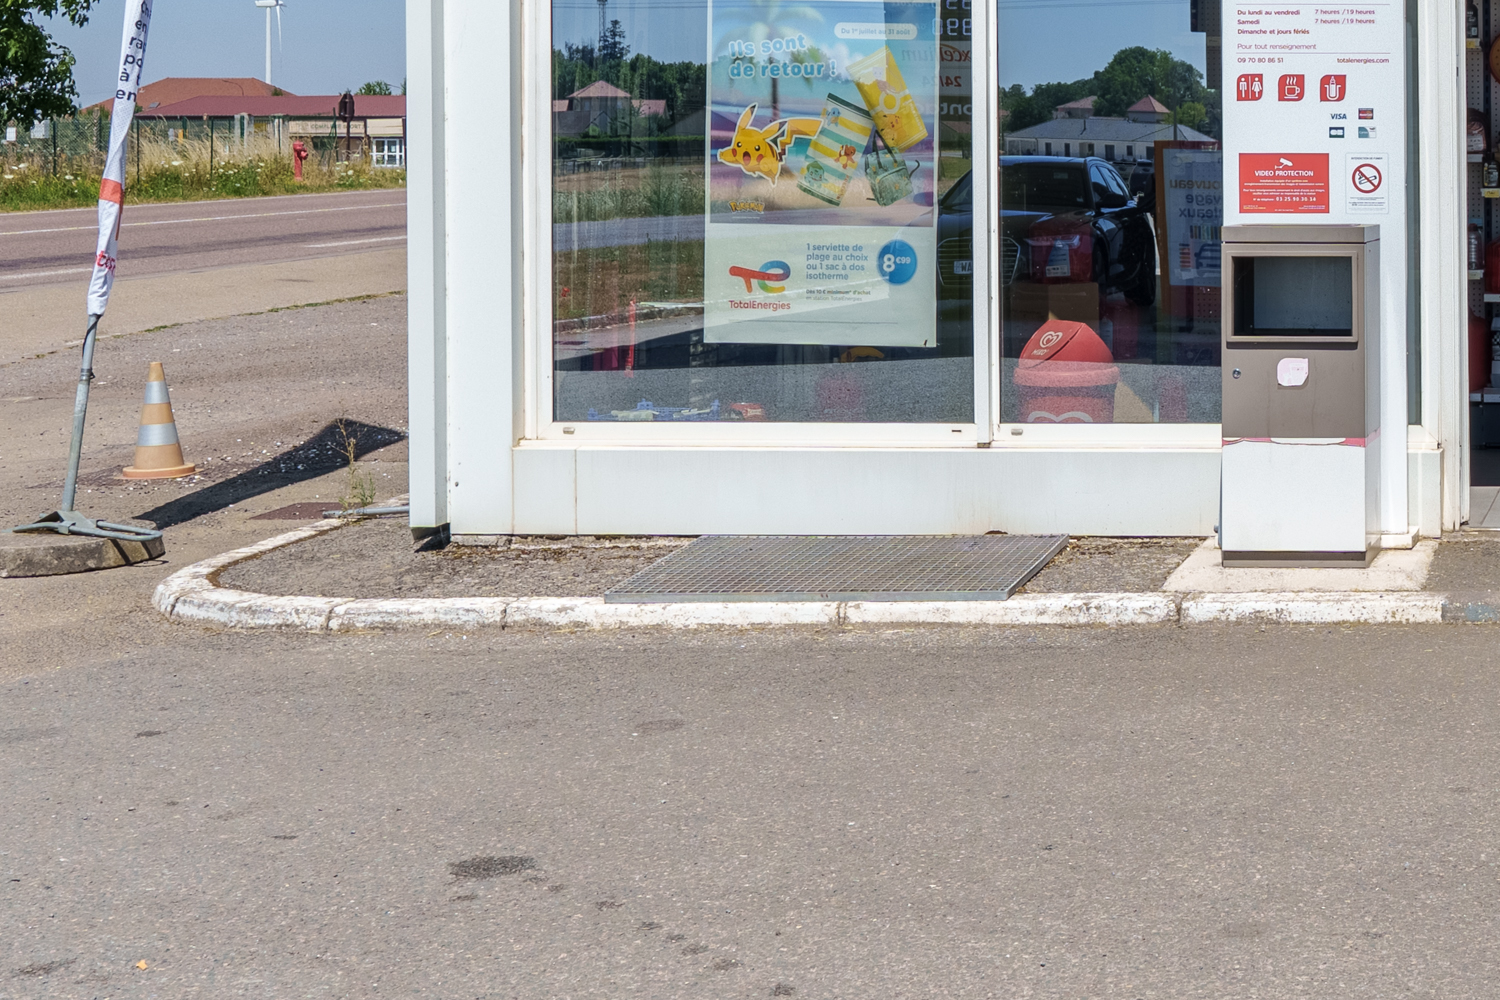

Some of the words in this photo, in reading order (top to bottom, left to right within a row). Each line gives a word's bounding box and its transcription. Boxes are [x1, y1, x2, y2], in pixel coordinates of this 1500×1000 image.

[1276, 28, 1292, 36] jours
[728, 39, 756, 58] Ils
[760, 33, 807, 55] sont
[1269, 43, 1317, 51] renseignement
[728, 61, 756, 79] de
[760, 61, 825, 79] retour
[812, 243, 850, 251] serviette
[852, 243, 863, 251] de
[806, 252, 830, 262] plage
[845, 253, 869, 261] choix
[841, 262, 847, 270] à
[849, 262, 865, 271] dos
[806, 272, 849, 280] isotherme
[728, 300, 791, 312] TotalEnergies
